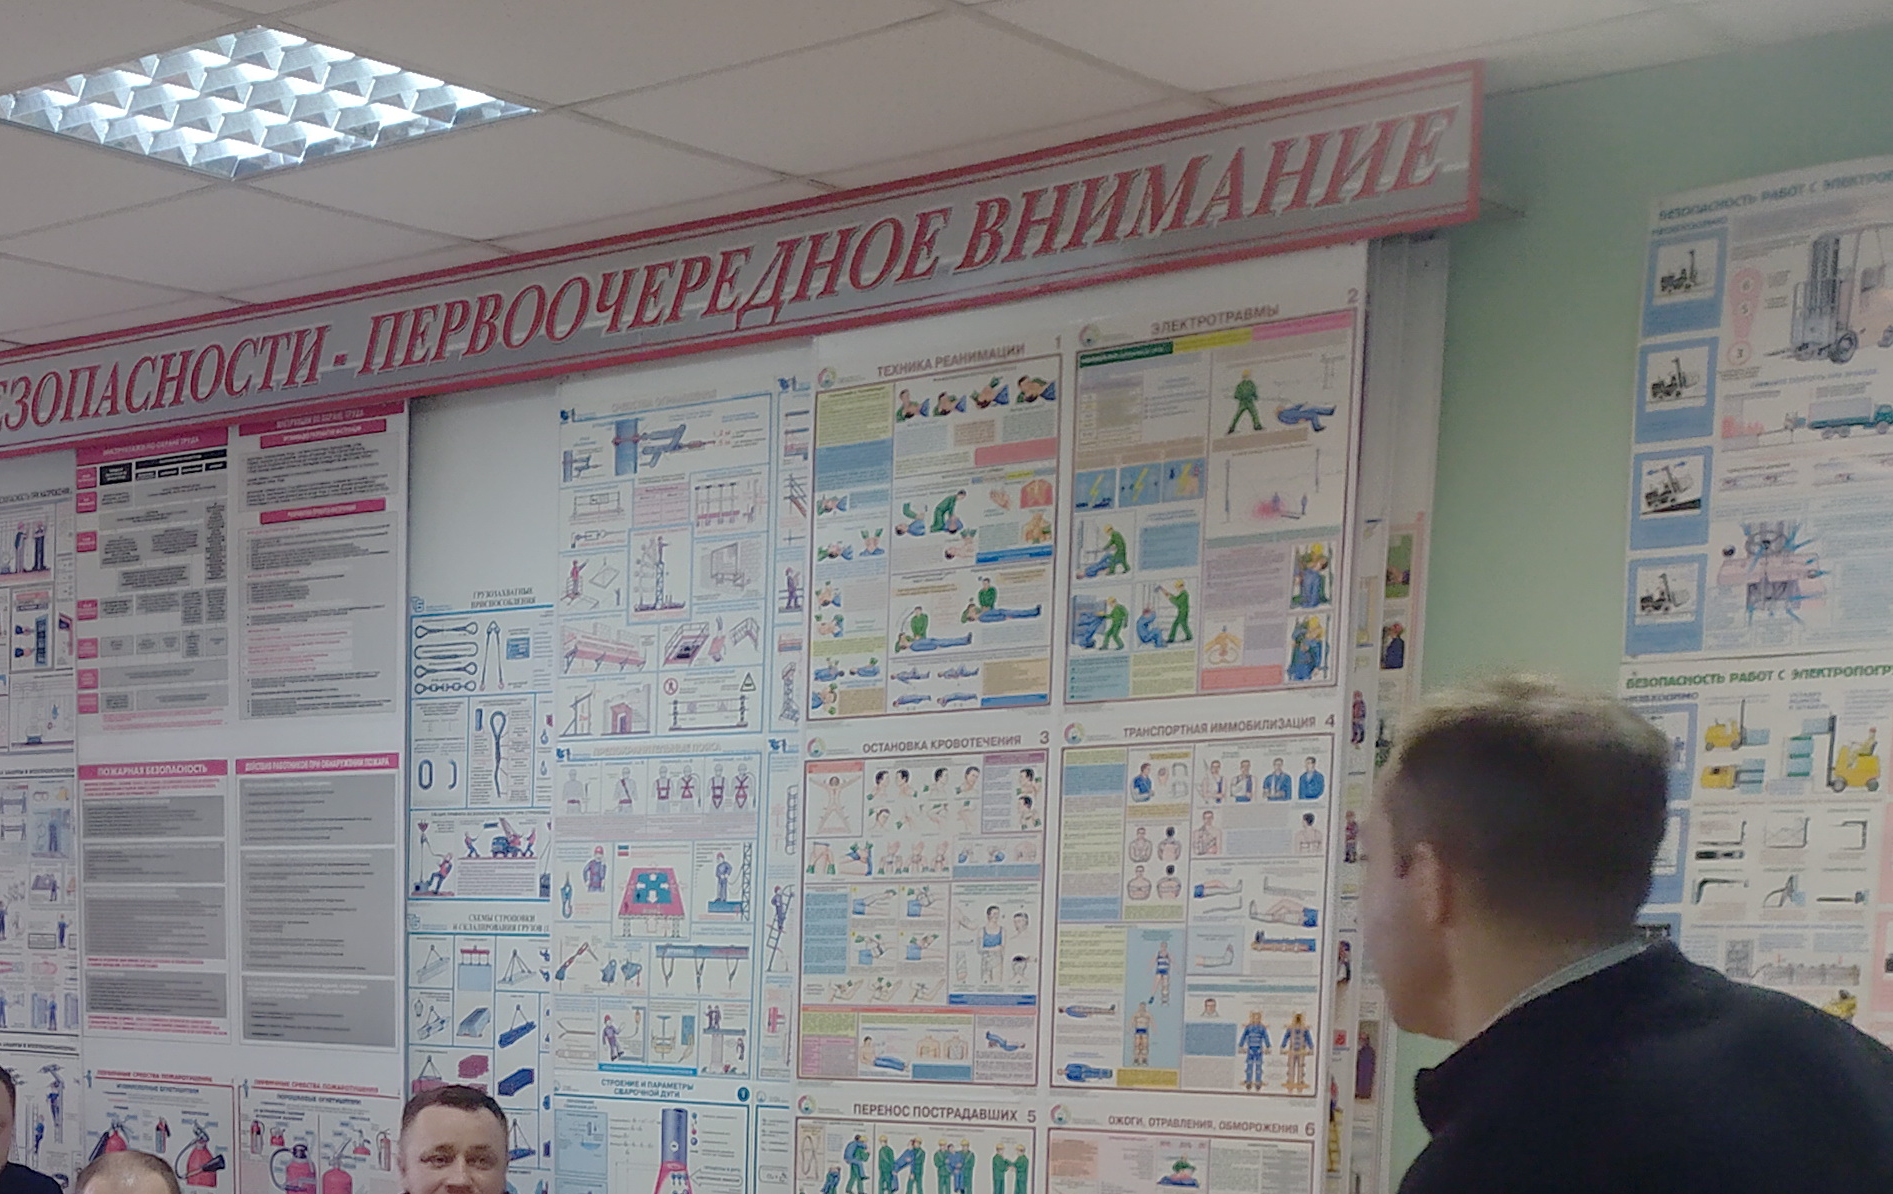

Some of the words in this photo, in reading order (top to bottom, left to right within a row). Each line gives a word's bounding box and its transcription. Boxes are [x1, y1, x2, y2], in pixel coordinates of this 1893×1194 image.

[358, 206, 952, 373] ПЕРВООЧЕРЕДНОЕ
[955, 105, 1459, 271] ВНИМАНИЕ
[1150, 304, 1280, 335] ЭЛЕКТРОТРАВМЫ
[1347, 287, 1358, 304] 2
[877, 358, 933, 378] ТЕХНИКА
[935, 343, 1025, 368] РЕАНИМАЦИИ
[1054, 334, 1062, 349] 1
[1626, 672, 1725, 689] БЕЗОПАСНОСТЬ
[1729, 670, 1774, 684] РАБОТ
[1777, 670, 1785, 681] С
[1790, 664, 1893, 681] ЭЛЕКТРОПОГР
[1122, 722, 1208, 738] ТРАНСПОРТНАЯ
[1210, 715, 1316, 734] ИММОБИЛИЗАЦИЯ
[1325, 713, 1335, 728] 4
[862, 739, 928, 754] ОСТАНОВКА
[930, 734, 1021, 751] КРОВОТЕЧЕНИЯ
[1040, 730, 1049, 744] 3
[98, 766, 144, 775] ПОЖАРНАЯ
[601, 1079, 639, 1088] СТРОЕНИЕ
[648, 1081, 694, 1091] ПАРАМЕТРЫ
[614, 1087, 659, 1096] СВАРОЧНОЙ
[661, 1090, 680, 1098] ДУГИ
[853, 1103, 911, 1118] ПЕРЕНОС
[913, 1105, 1019, 1121] ПОСТРАДАВШИХ
[1028, 1110, 1037, 1124] 5
[1219, 1120, 1298, 1134] ОБМОРОЖЕНИЯ
[1304, 1121, 1315, 1136] 6
